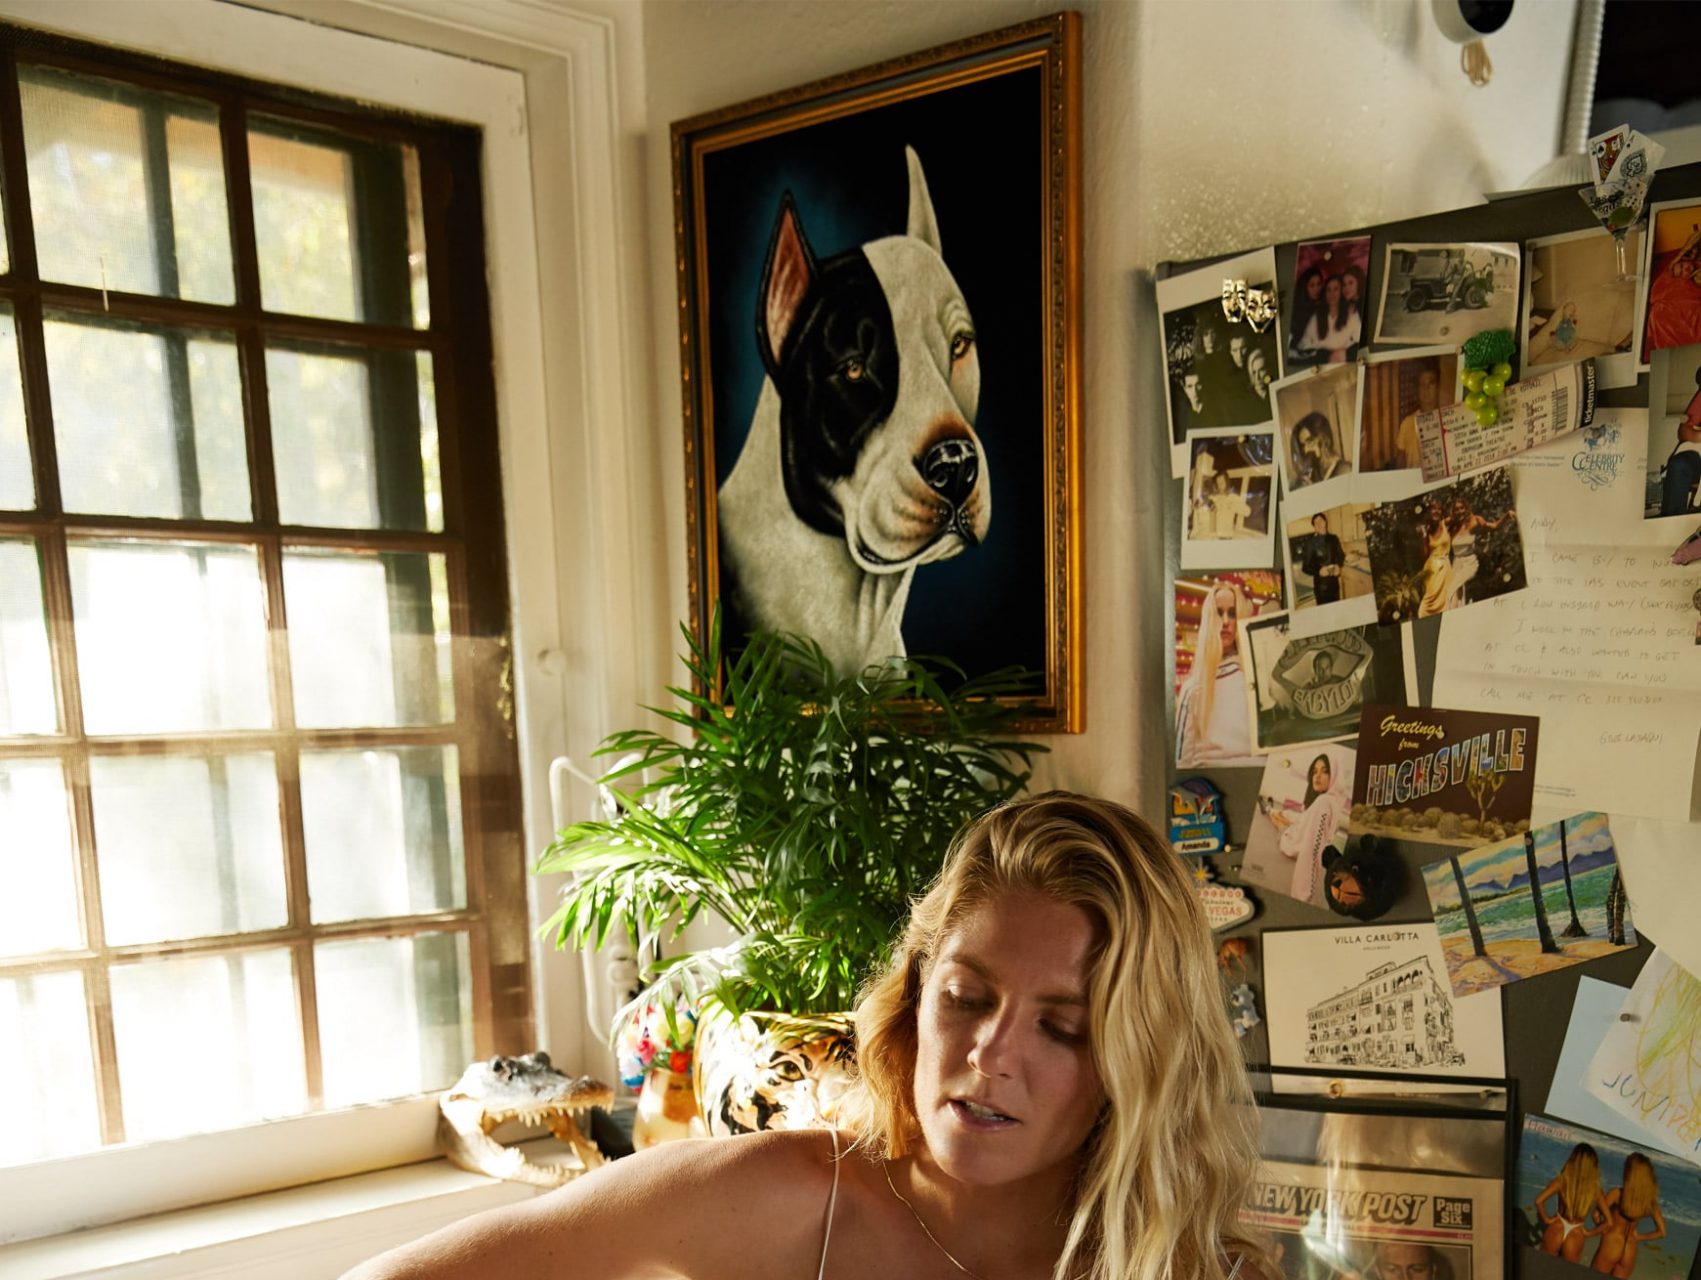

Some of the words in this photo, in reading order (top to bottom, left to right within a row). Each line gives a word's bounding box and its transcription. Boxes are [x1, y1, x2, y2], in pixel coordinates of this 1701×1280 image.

[1584, 365, 1596, 424] ticketmaster
[1572, 451, 1625, 471] CELEBRITY
[1380, 714, 1443, 740] Greetings
[1398, 738, 1420, 751] from
[1366, 728, 1527, 807] HICKSVILLE
[1335, 935, 1361, 945] VILLA
[1602, 1071, 1701, 1152] JUNIPE
[1251, 1183, 1298, 1215] NEW
[1361, 1192, 1426, 1225] POST
[1436, 1199, 1471, 1214] Page
[1441, 1211, 1463, 1225] Six
